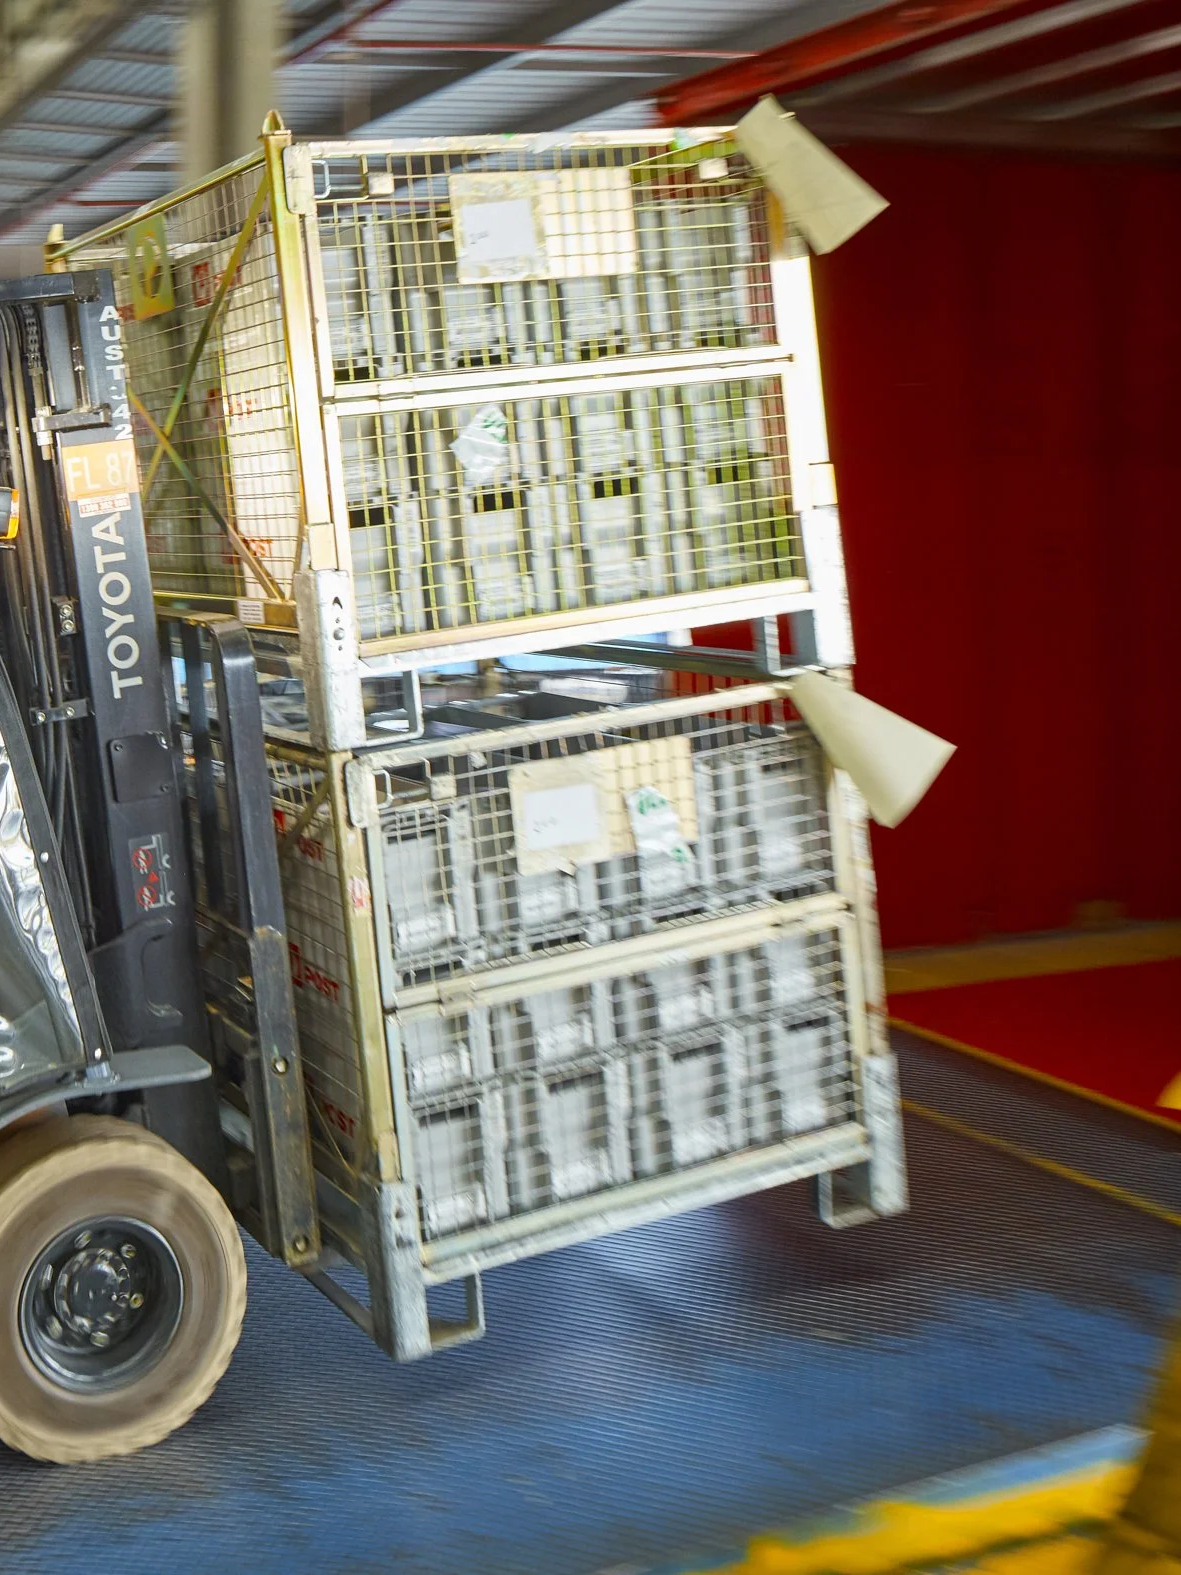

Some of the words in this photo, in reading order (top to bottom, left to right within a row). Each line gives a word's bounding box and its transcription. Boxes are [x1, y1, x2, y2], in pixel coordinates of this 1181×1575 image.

[67, 456, 101, 492] FL
[106, 451, 134, 487] 87
[91, 511, 144, 699] TOYOTA
